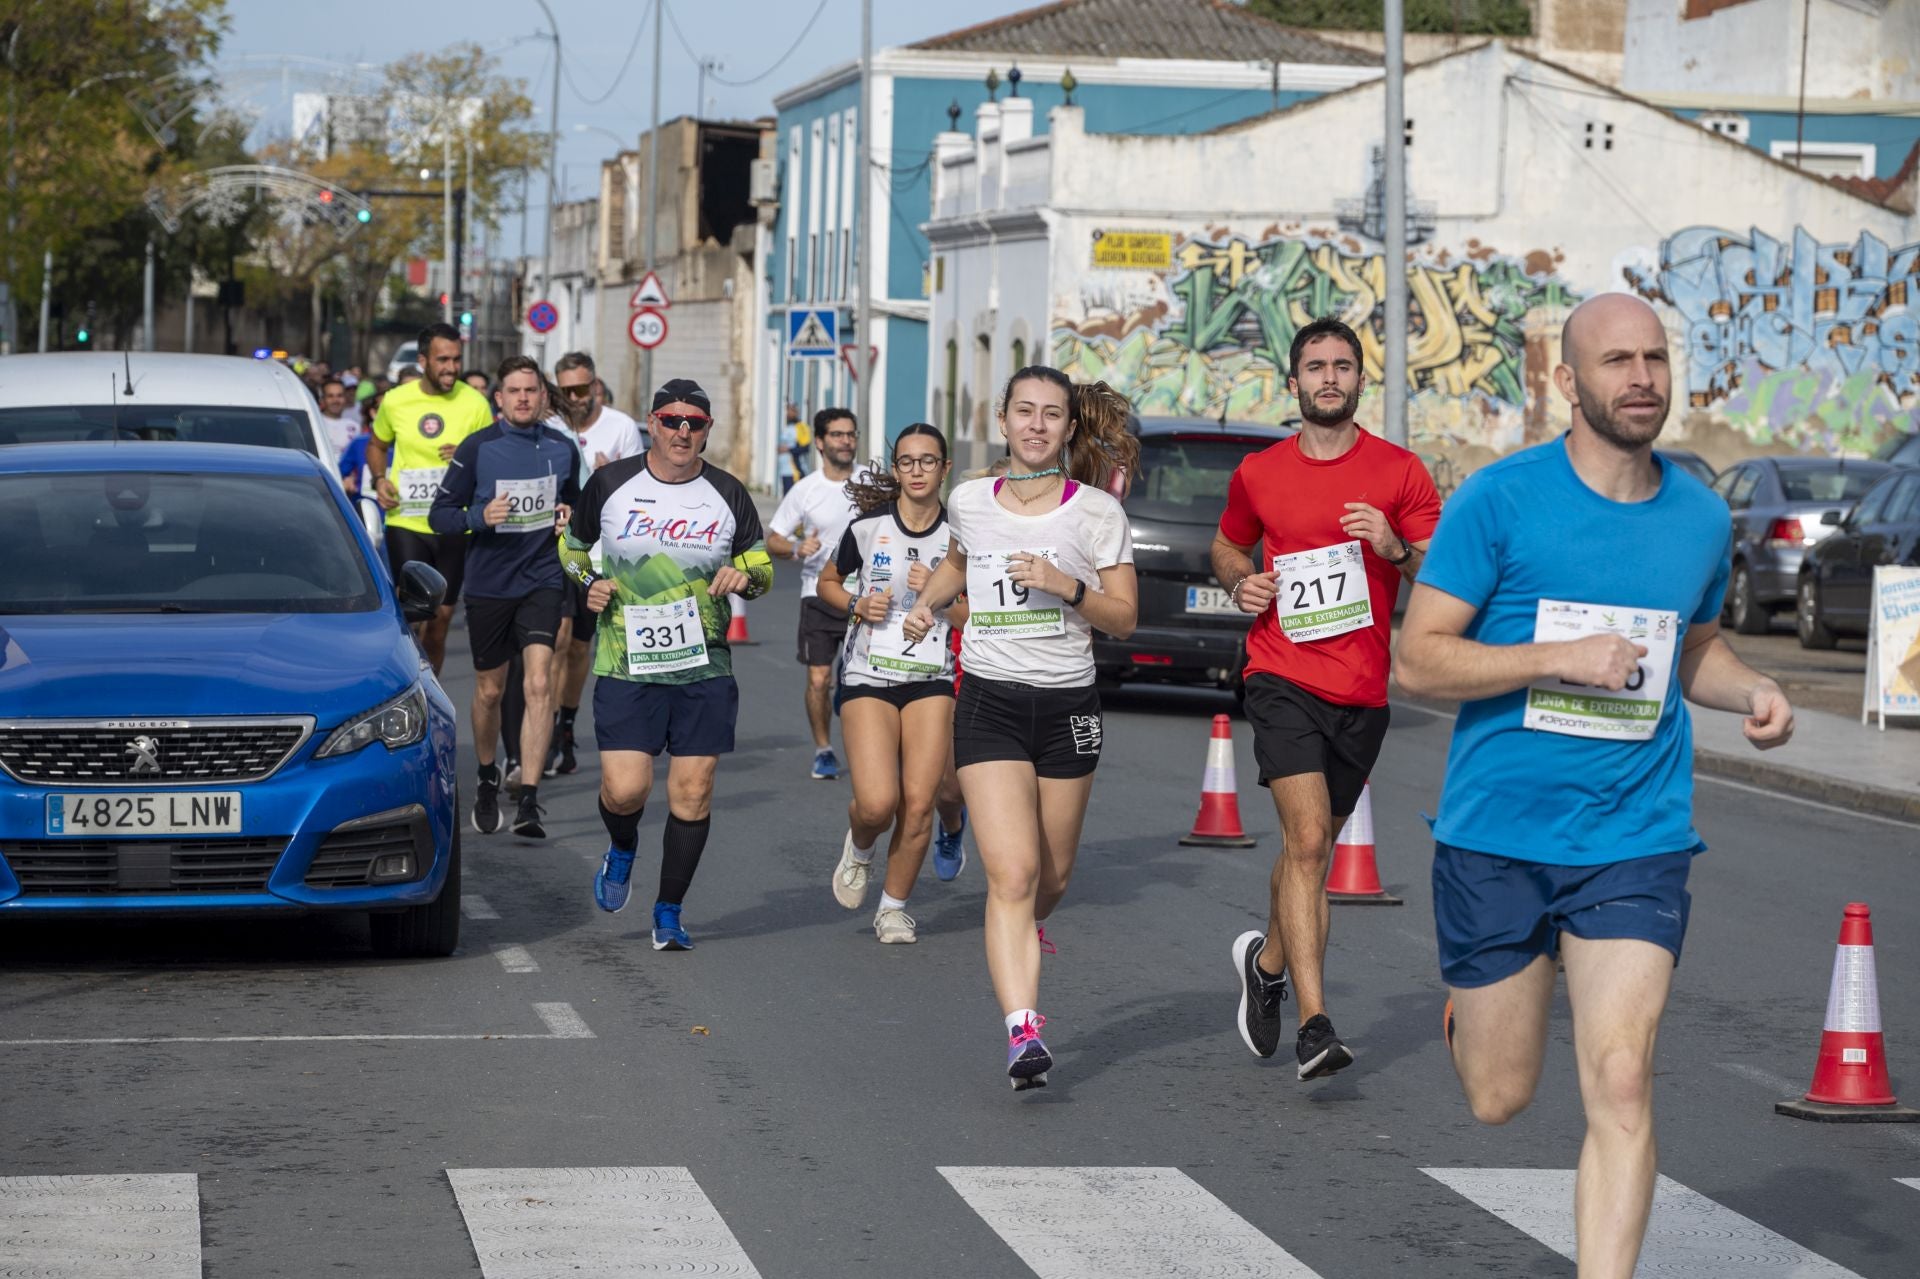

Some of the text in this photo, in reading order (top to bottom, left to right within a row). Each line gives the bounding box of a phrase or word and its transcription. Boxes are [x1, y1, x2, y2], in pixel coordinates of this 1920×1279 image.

[636, 320, 661, 336] 30
[509, 493, 545, 513] 206
[660, 540, 713, 552] TRAIL RUNNING
[992, 578, 1030, 607] 19
[1290, 571, 1347, 610] 217
[973, 611, 1058, 625] JUNTA DE EXTREMADURA
[1284, 603, 1367, 629] JUNTA DE EXTREMADURA
[641, 621, 686, 649] 331
[632, 645, 703, 663] JUNTA DE EXTREMADA
[1535, 693, 1657, 716] JUNTA DE EXTREMADURA
[71, 796, 231, 828] 4825 LNW
